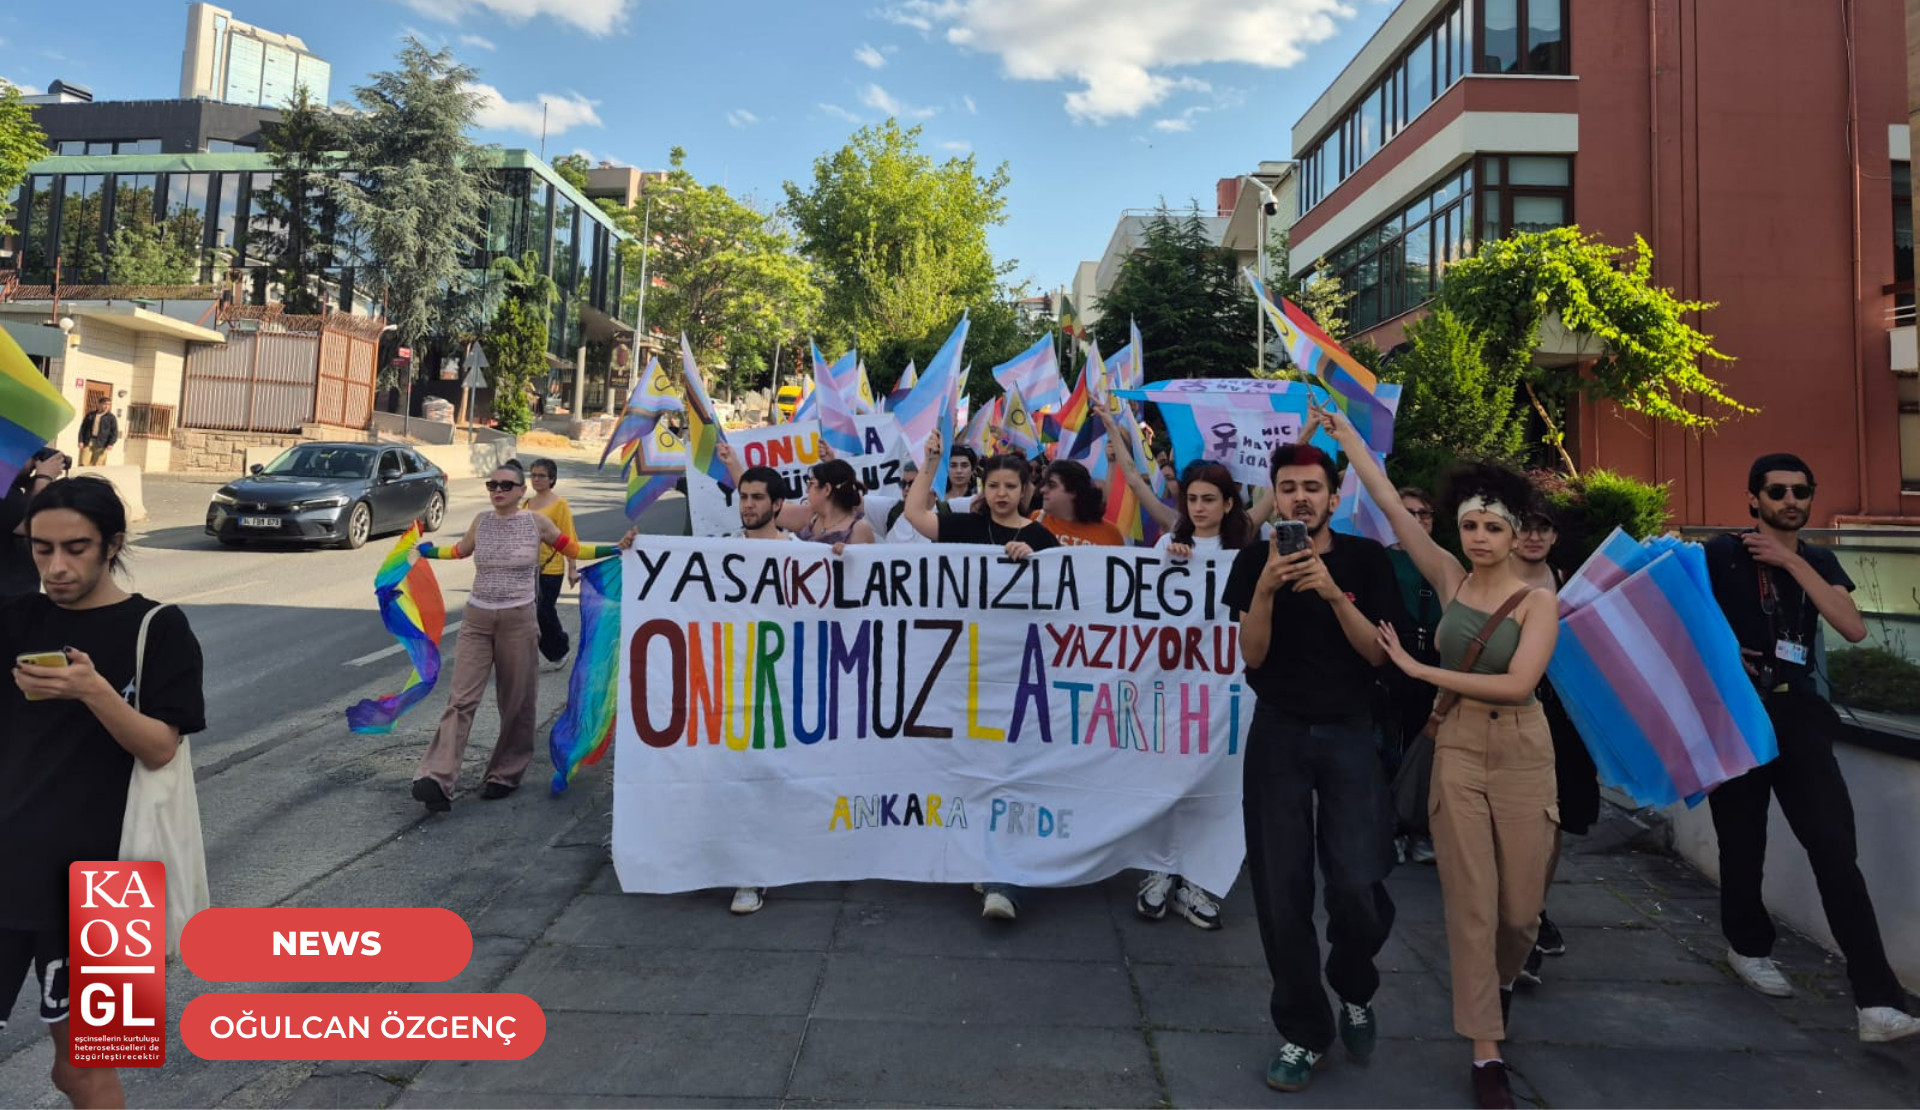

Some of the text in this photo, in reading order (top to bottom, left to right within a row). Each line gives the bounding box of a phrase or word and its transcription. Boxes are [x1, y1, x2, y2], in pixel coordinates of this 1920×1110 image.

[636, 550, 1079, 610] YASA(K)LARINIZLA
[1045, 623, 1246, 675] YAZIYORU
[630, 618, 1052, 751] ONURUMUZLA
[1053, 680, 1241, 755] TARİHİ
[829, 793, 967, 832] ANKARA
